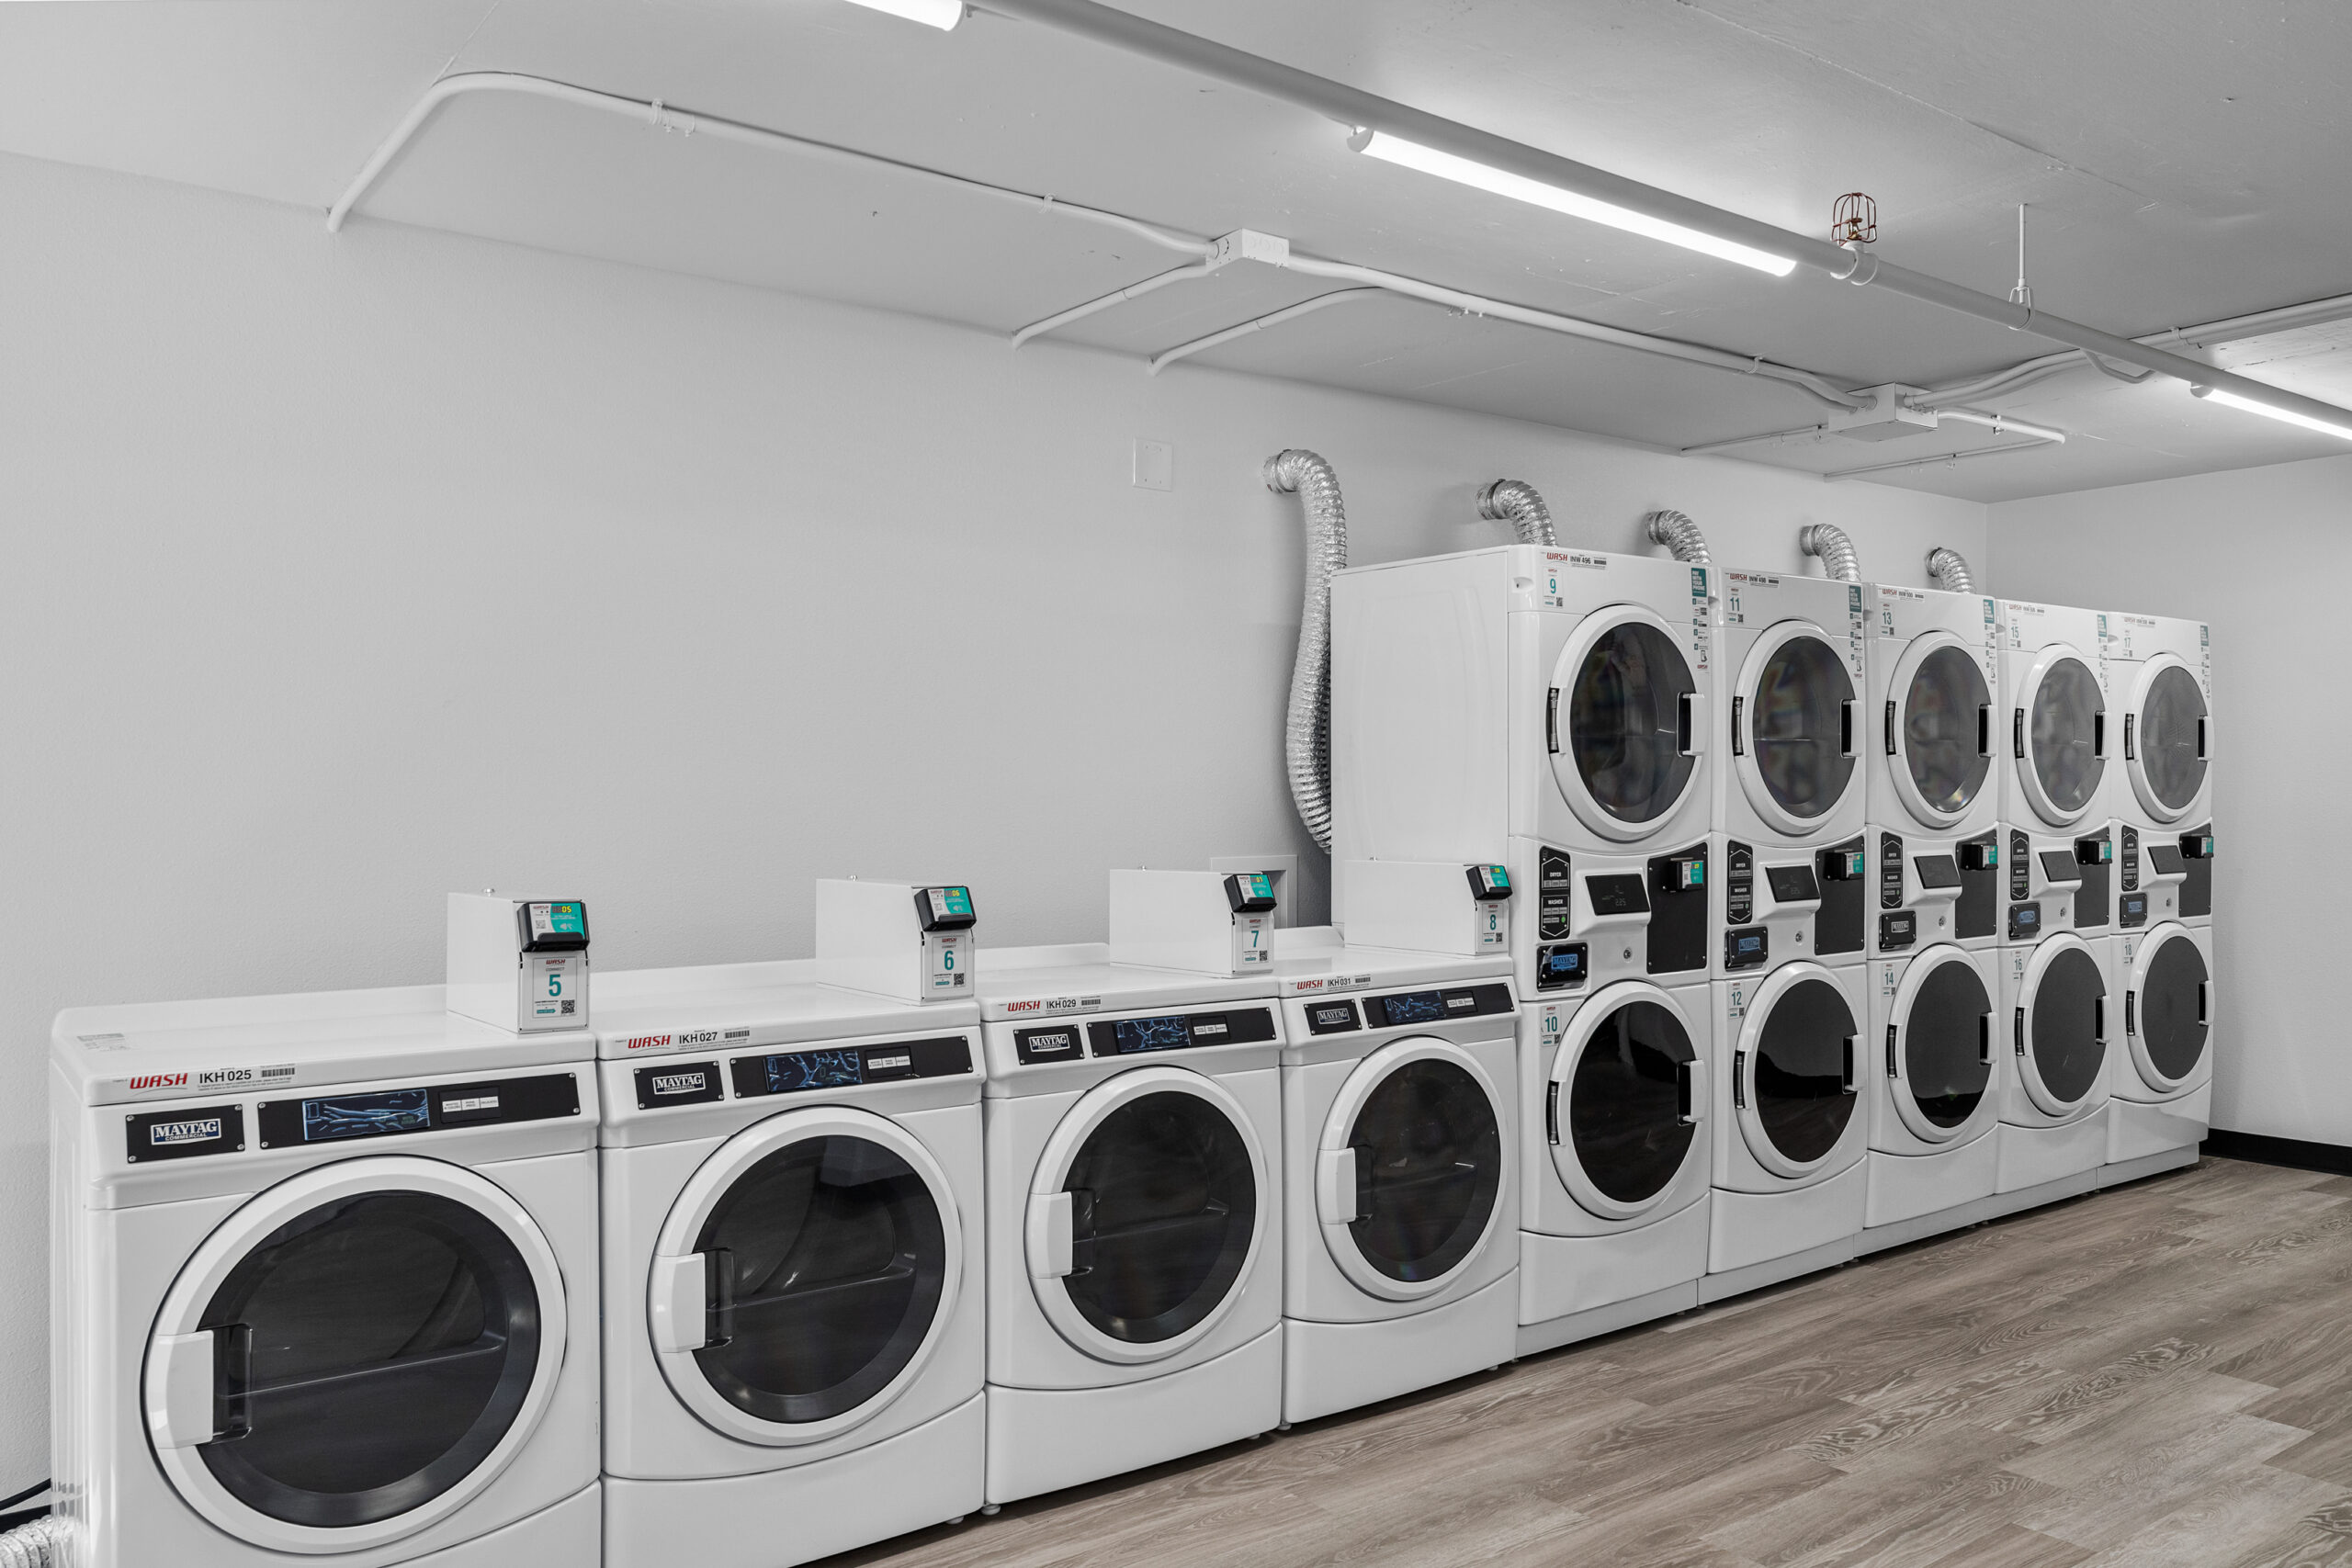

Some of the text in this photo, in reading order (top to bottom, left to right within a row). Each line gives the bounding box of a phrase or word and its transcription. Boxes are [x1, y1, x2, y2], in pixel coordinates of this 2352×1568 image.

[1546, 552, 1568, 561] WASH
[1550, 578, 1556, 594] 9
[1729, 597, 1740, 612] 11
[1883, 612, 1892, 625] 13
[2010, 626, 2019, 638] 15
[2124, 637, 2132, 648] 17
[1489, 914, 1497, 931] 8
[1251, 930, 1259, 948] 7
[944, 951, 954, 970] 6
[2015, 958, 2022, 970] 16
[548, 974, 561, 997] 5
[1296, 979, 1323, 990] WASH
[1885, 973, 1894, 985] 14
[1007, 1000, 1040, 1012] WASH
[1046, 1000, 1061, 1010] IKH
[1062, 999, 1076, 1008] 029
[1732, 991, 1742, 1006] 12
[1319, 1010, 1347, 1020] MAYTAG
[1545, 1016, 1557, 1032] 10
[628, 1034, 671, 1049] WASH
[679, 1034, 698, 1044] IKH
[700, 1032, 718, 1043] 027
[1032, 1036, 1067, 1047] MAYTAG
[130, 1073, 188, 1089] WASH
[199, 1072, 225, 1084] IKH
[227, 1069, 252, 1081] 025
[656, 1075, 702, 1089] MAYTAG
[154, 1122, 217, 1138] MAYTAG
[165, 1133, 208, 1141] COMMERCIAL
